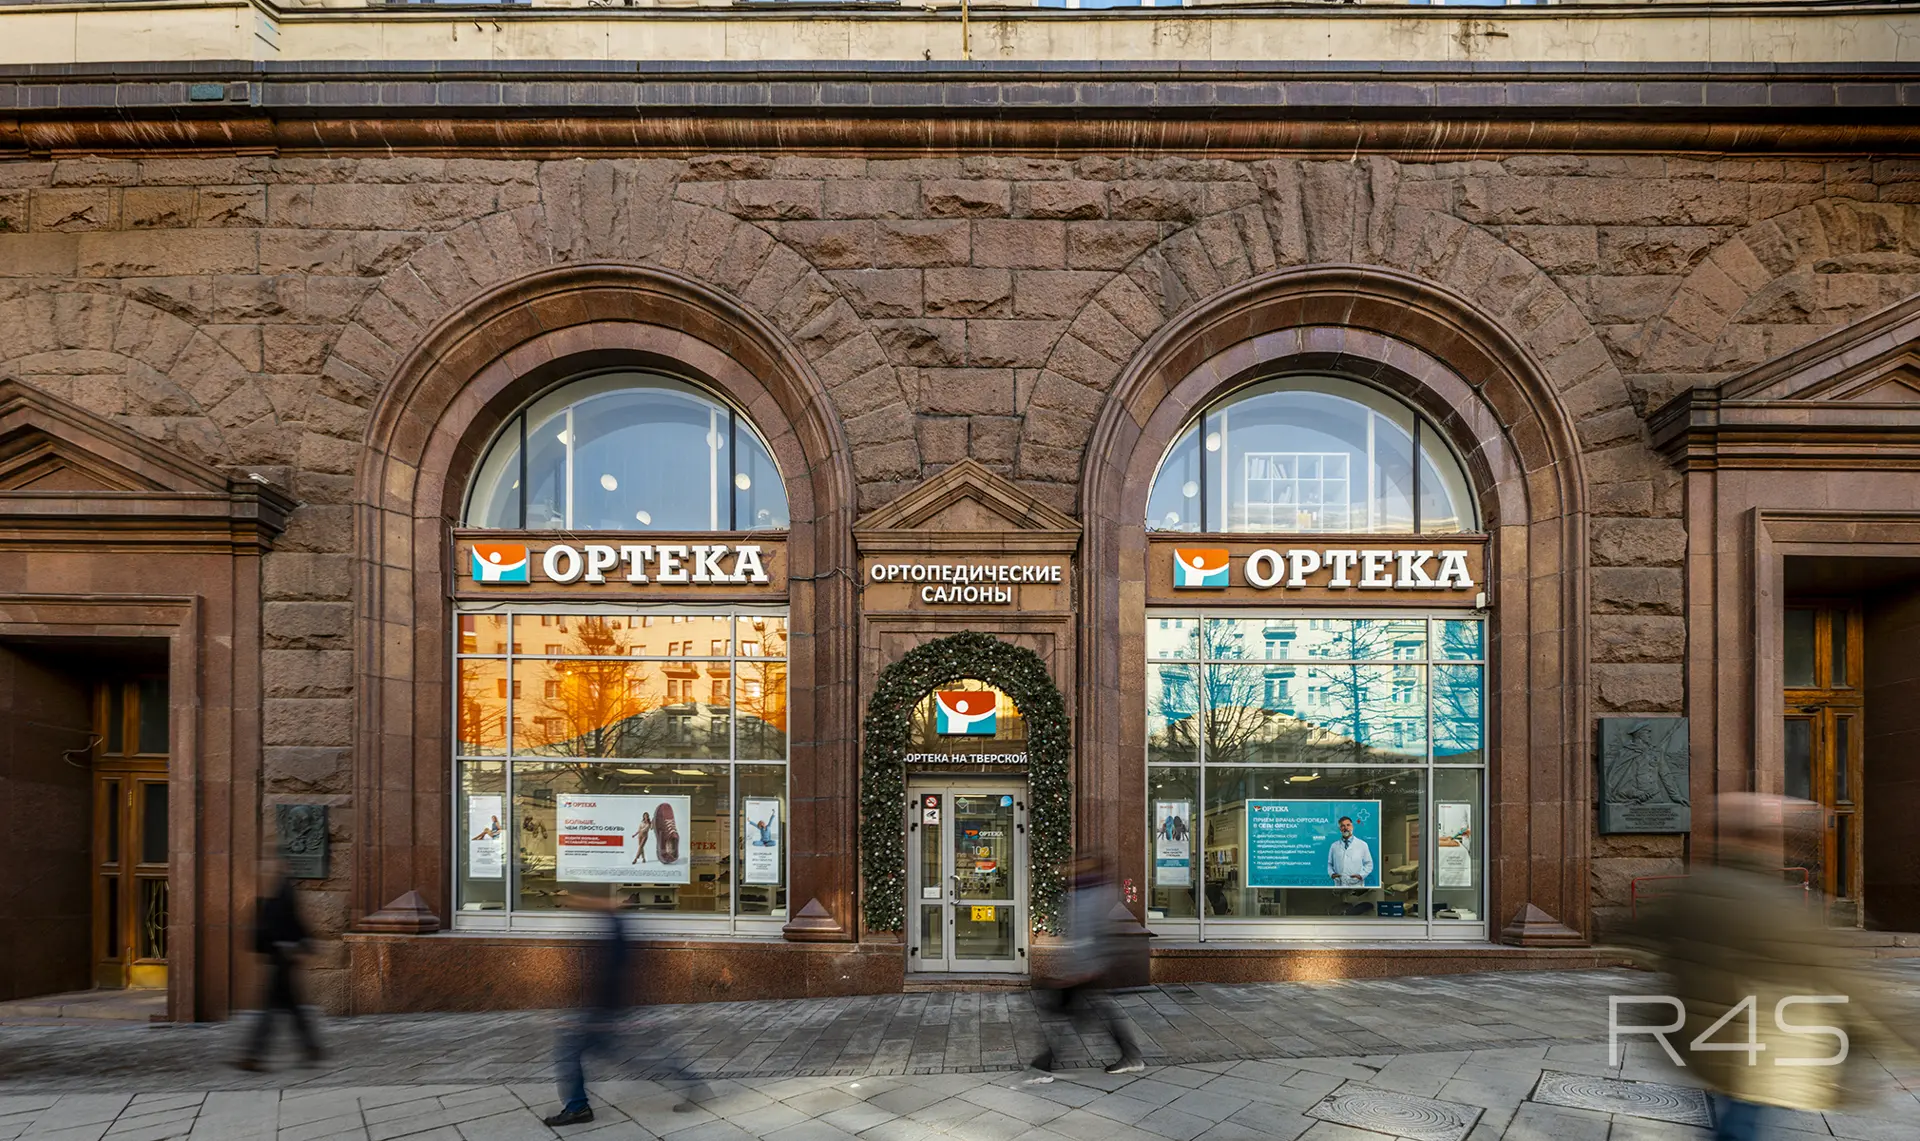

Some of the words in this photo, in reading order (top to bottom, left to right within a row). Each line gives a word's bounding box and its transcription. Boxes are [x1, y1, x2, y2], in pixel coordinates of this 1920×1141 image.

[543, 544, 769, 585] ОРТЕКА
[871, 564, 1062, 584] ОРТОПЕДИЧЕСКИЕ
[1244, 549, 1475, 589] ОРТЕКА
[921, 586, 1012, 603] САЛОНЫ
[906, 753, 949, 763] ОРТЕКА
[951, 753, 968, 763] НА
[969, 751, 1028, 763] ТВЕРСКОЙ
